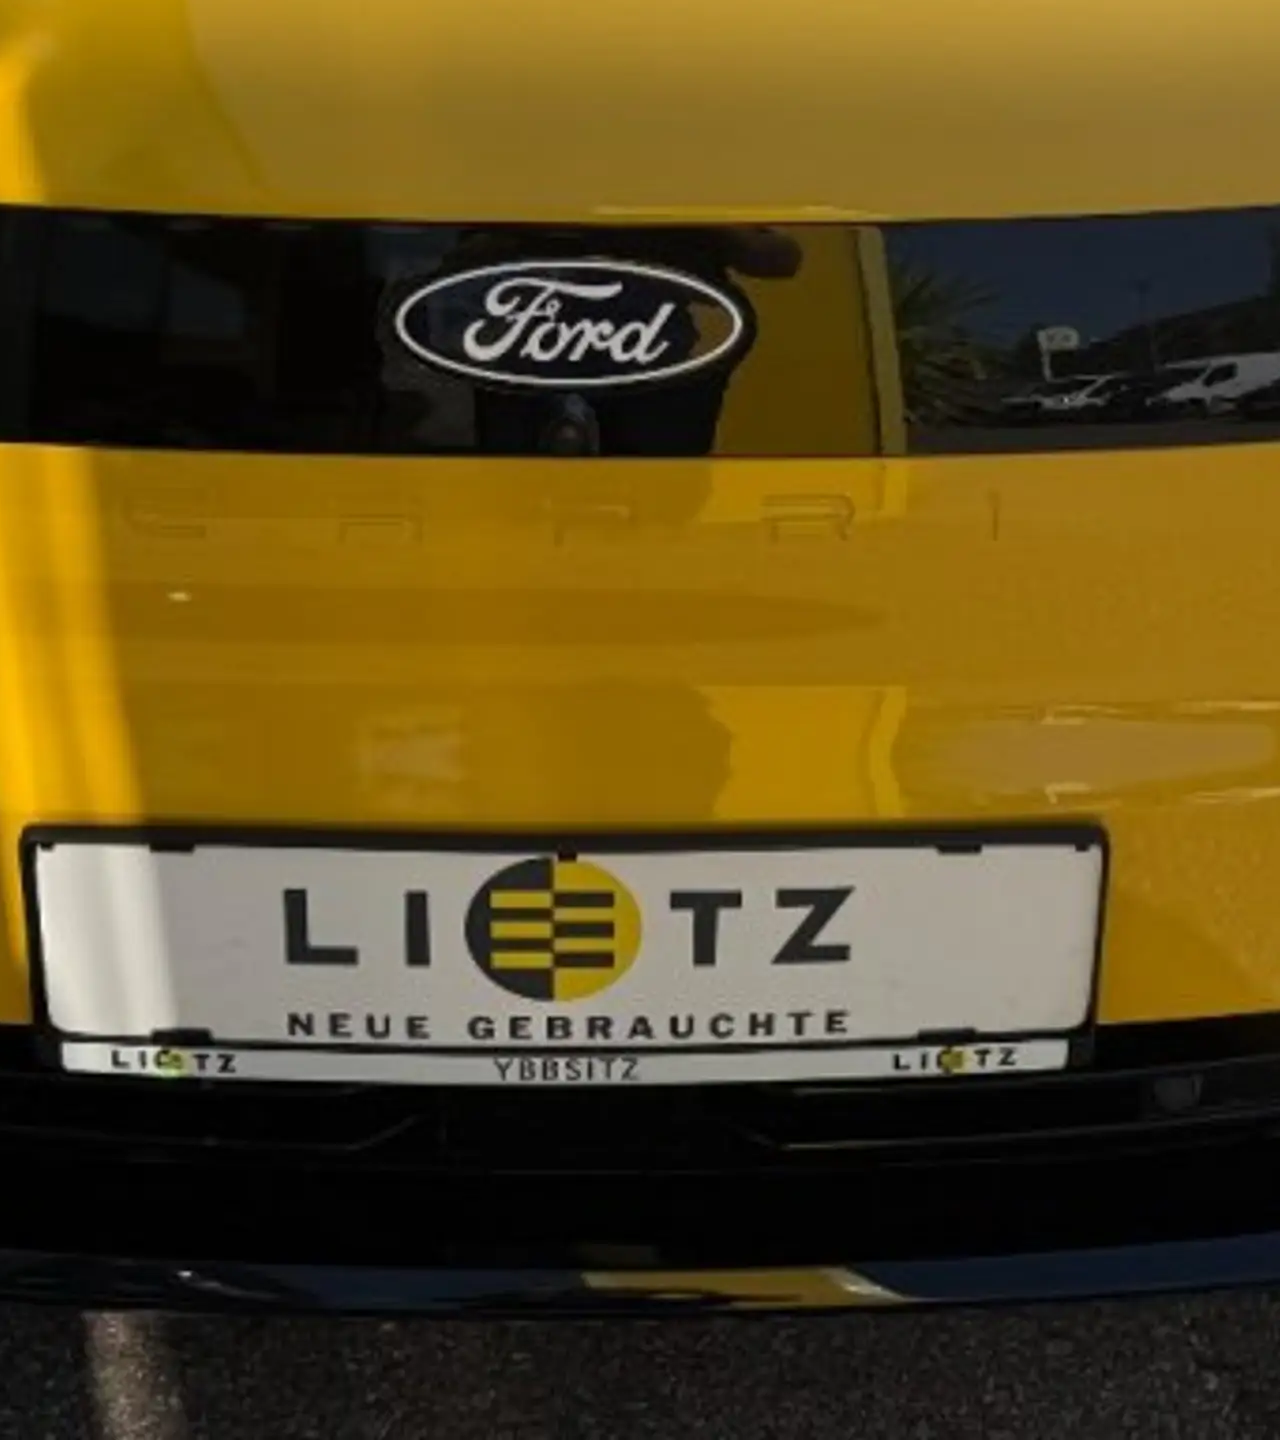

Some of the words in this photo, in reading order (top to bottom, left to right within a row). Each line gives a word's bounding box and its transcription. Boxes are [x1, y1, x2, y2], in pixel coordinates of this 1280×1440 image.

[462, 276, 677, 366] Ford
[287, 1013, 431, 1040] NEUE
[467, 1010, 851, 1042] GEBRAUCHTE
[493, 1056, 639, 1081] YBBSITZ
